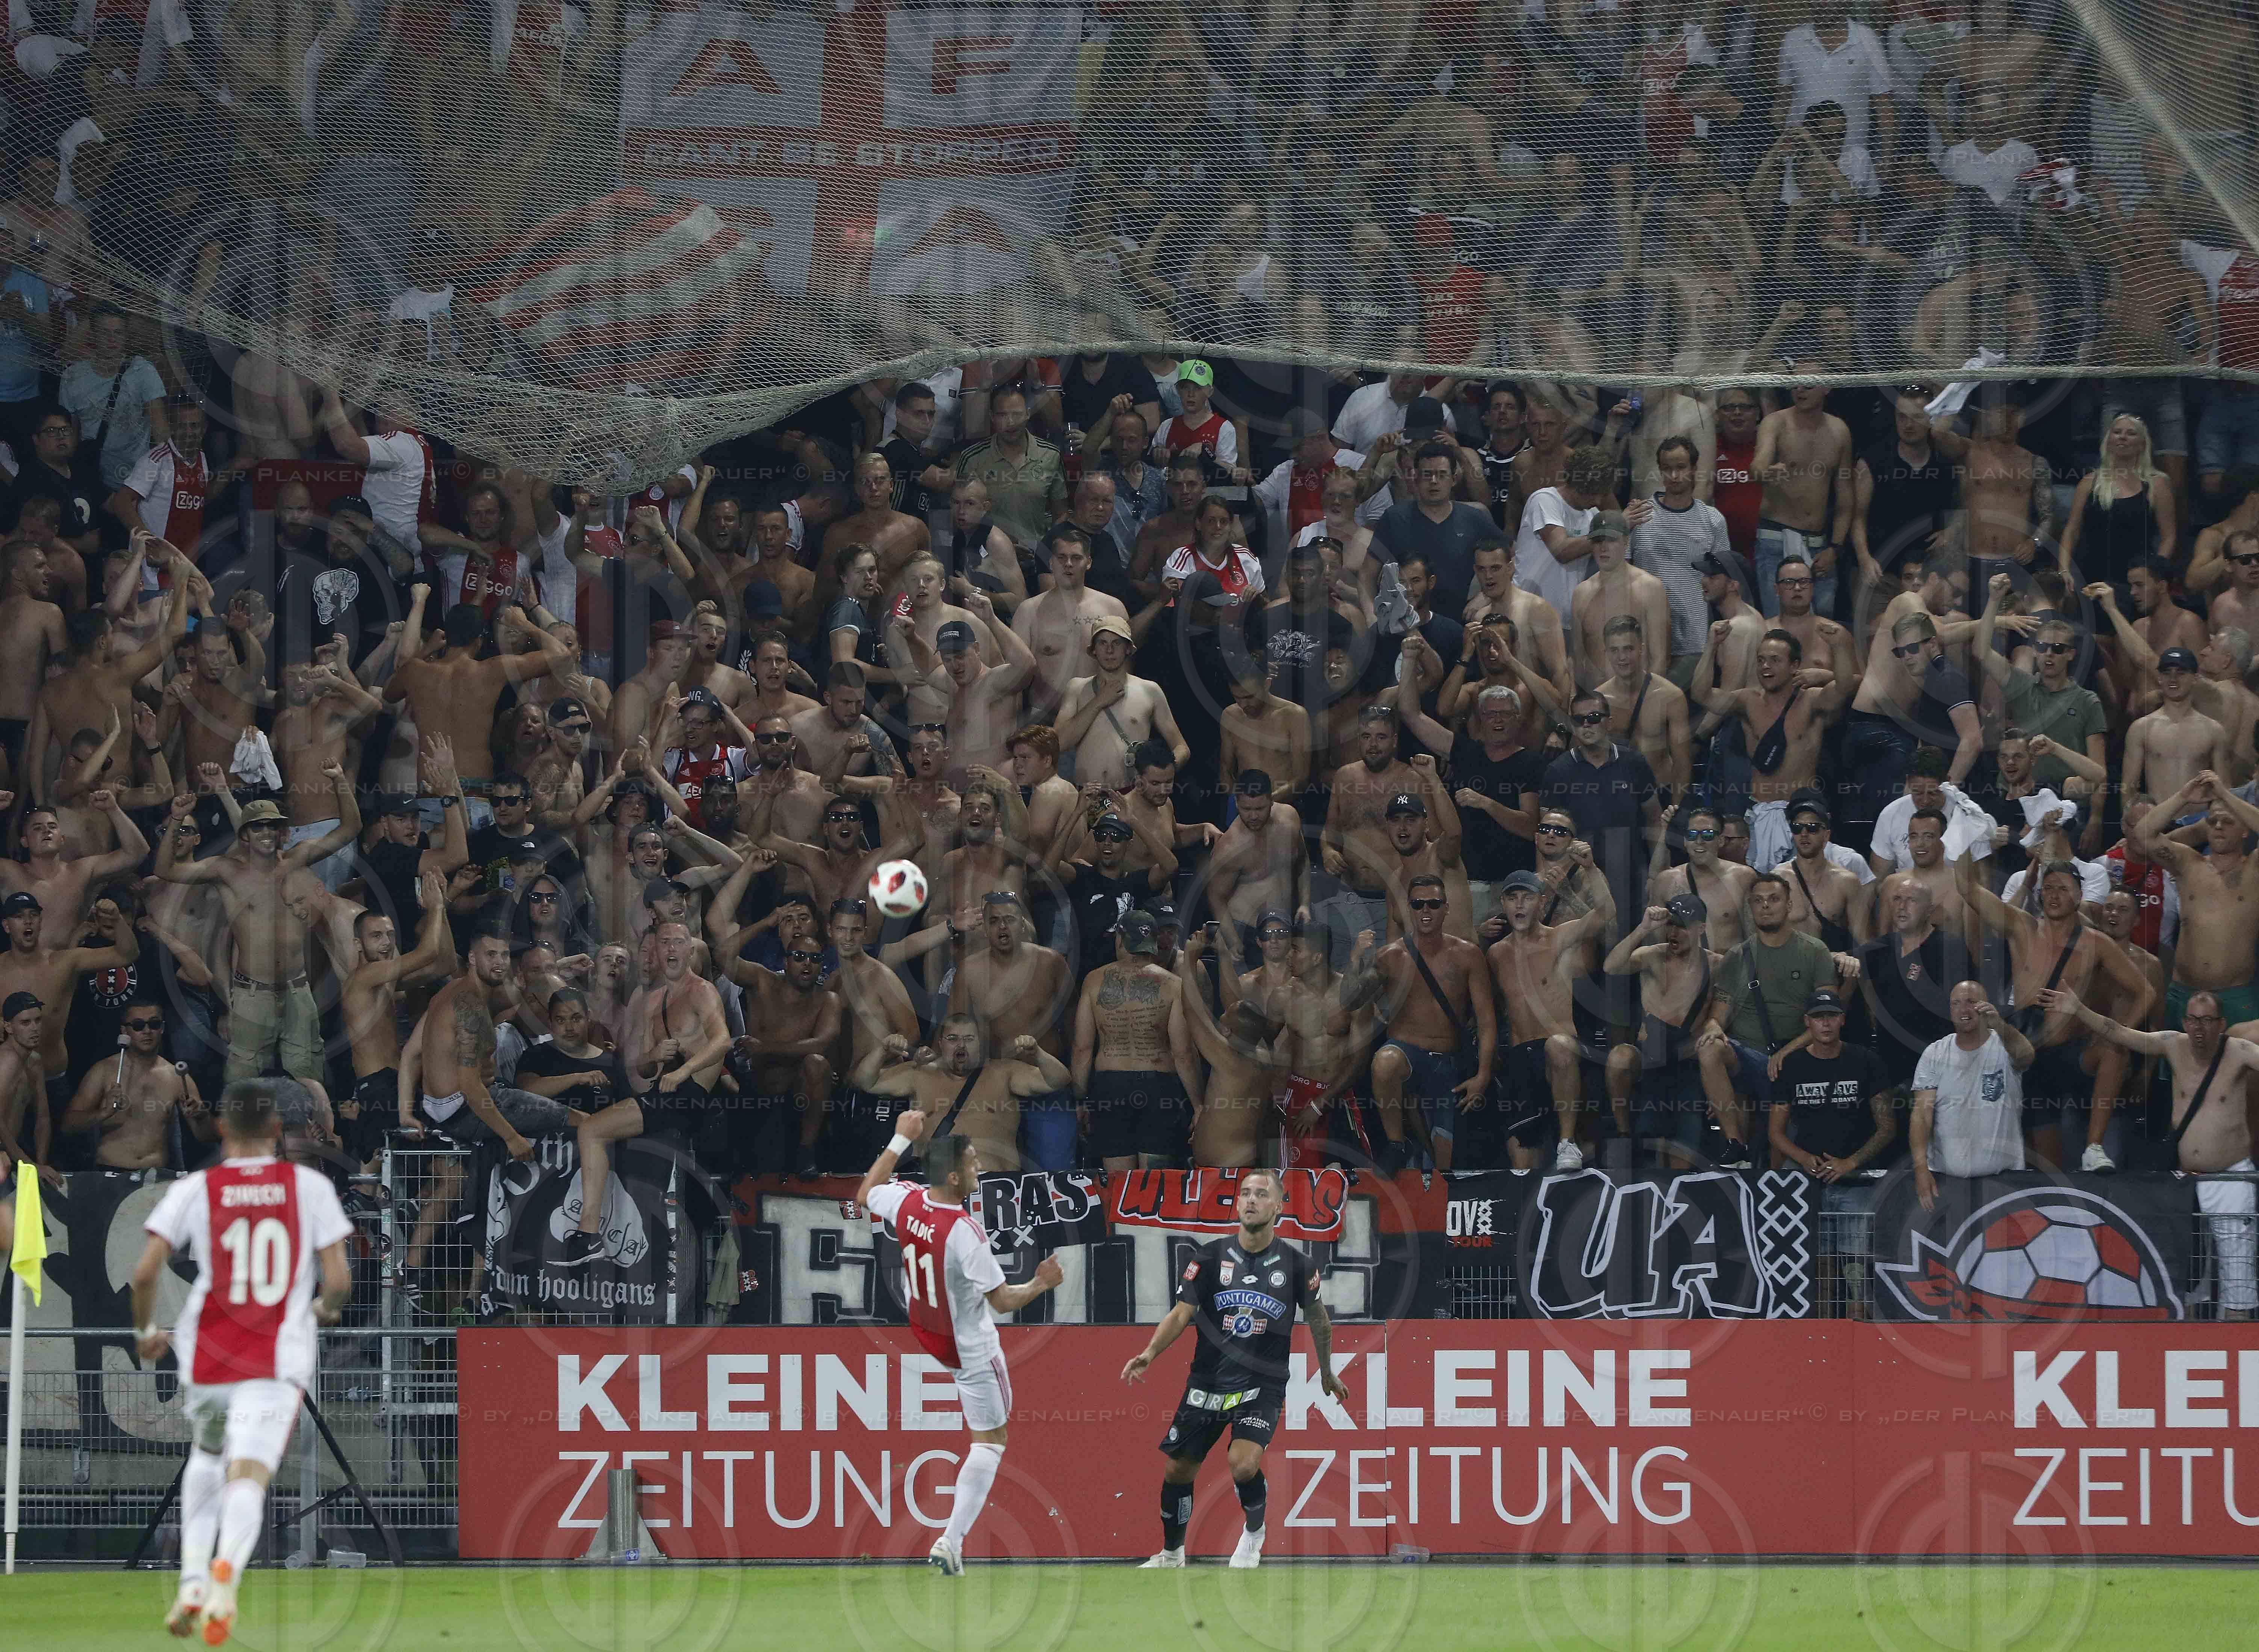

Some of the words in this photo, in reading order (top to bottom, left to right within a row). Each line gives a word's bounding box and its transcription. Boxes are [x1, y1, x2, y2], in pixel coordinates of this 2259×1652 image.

[220, 1217, 290, 1306] 10
[906, 1214, 936, 1244] TADIĆ
[1451, 1236, 1494, 1248] TOUR
[538, 1269, 656, 1309] hooligans
[902, 1242, 938, 1309] 11
[1216, 1292, 1285, 1318] PUNTIGAMER
[558, 1354, 963, 1431] KLEINE
[1189, 1388, 1255, 1409] GRAZ
[1285, 1349, 1691, 1430] KLEINE
[558, 1449, 960, 1529] ZEITUNG
[1284, 1445, 1691, 1527] ZEITUNG
